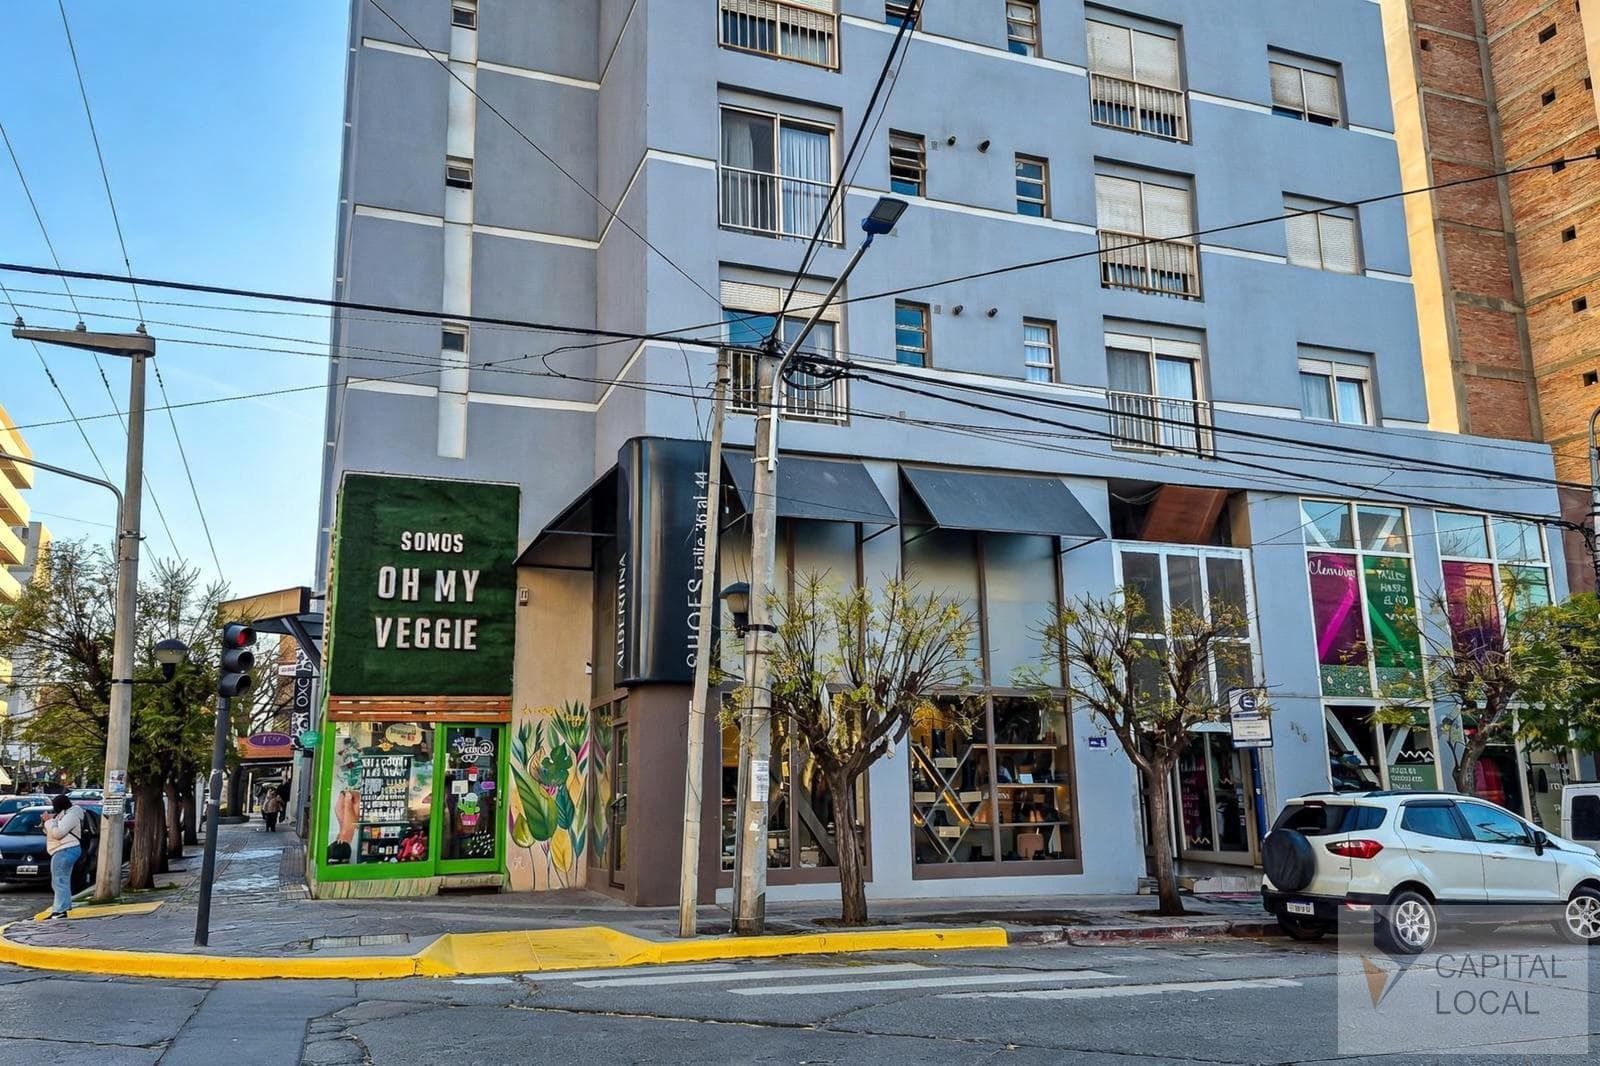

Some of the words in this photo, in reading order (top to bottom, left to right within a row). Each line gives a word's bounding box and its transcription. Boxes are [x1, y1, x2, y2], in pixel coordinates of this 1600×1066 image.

[694, 471, 708, 489] 44
[401, 531, 464, 553] SOMOS
[377, 565, 420, 601] OH
[434, 569, 480, 602] MY
[375, 617, 478, 650] VEGGIE
